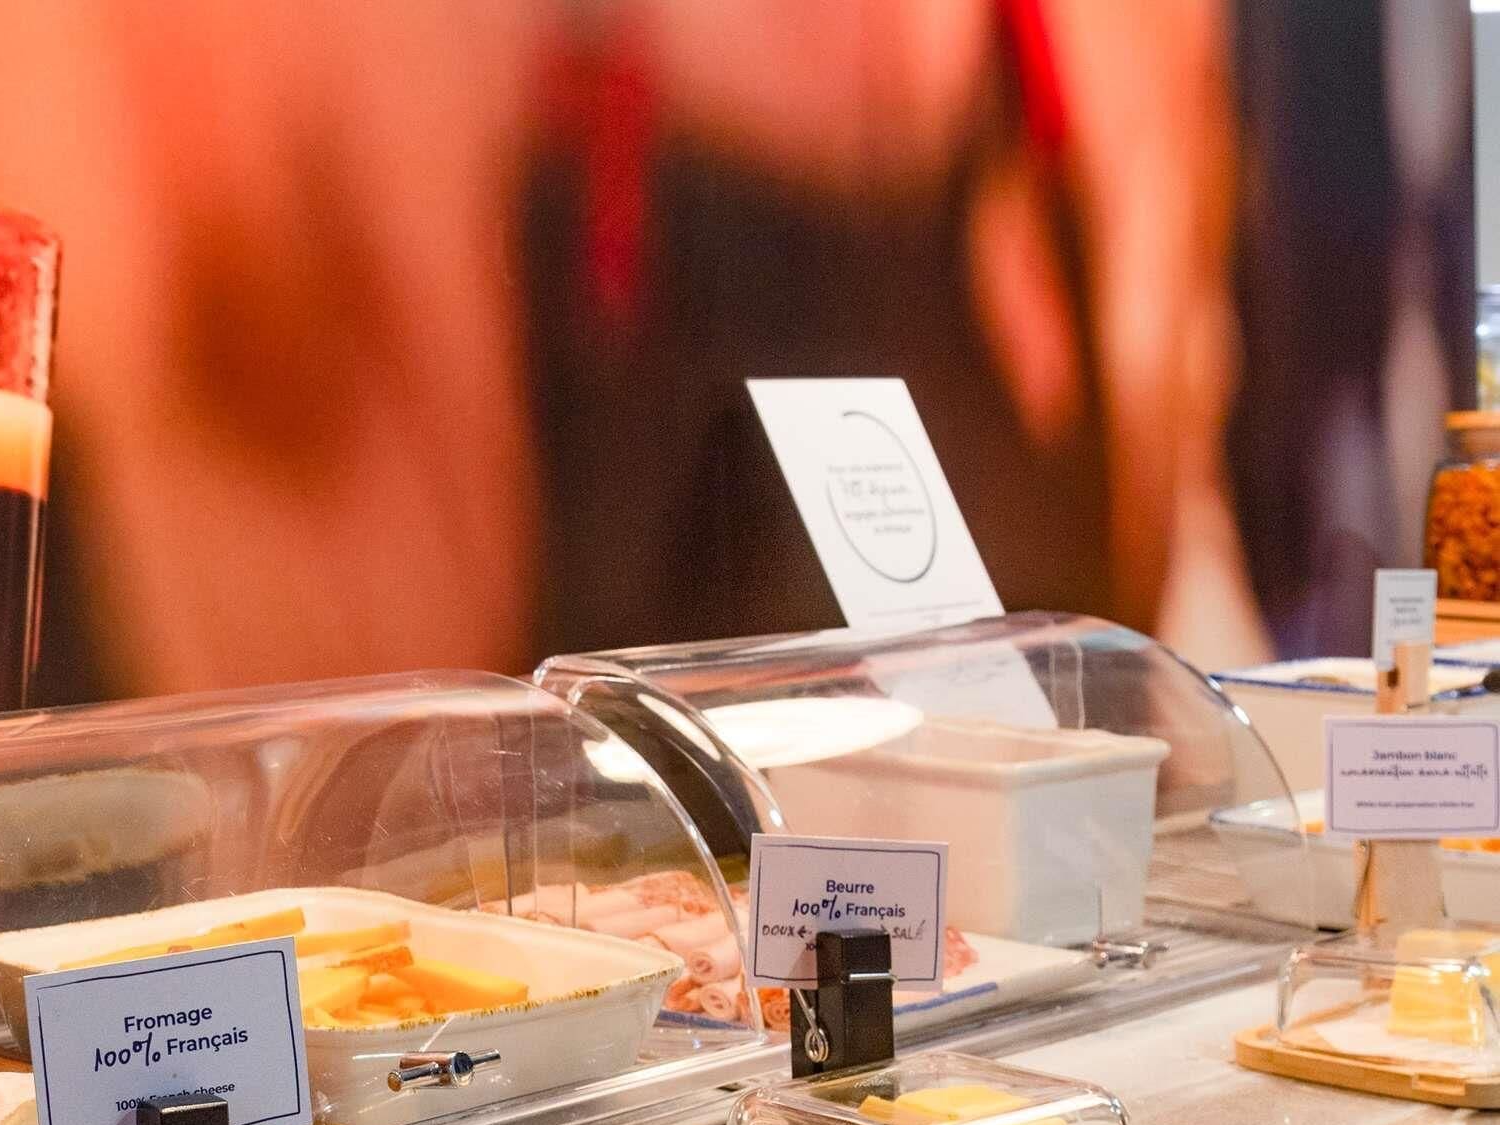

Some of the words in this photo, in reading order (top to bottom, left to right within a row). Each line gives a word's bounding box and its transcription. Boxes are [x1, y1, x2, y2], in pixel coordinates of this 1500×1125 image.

[826, 880, 875, 894] Beurre
[792, 895, 841, 921] 100%
[845, 903, 906, 920] Français
[762, 924, 794, 937] DOUX
[124, 1007, 213, 1033] Fromage
[94, 1032, 161, 1072] 100%
[166, 1027, 249, 1055] Français
